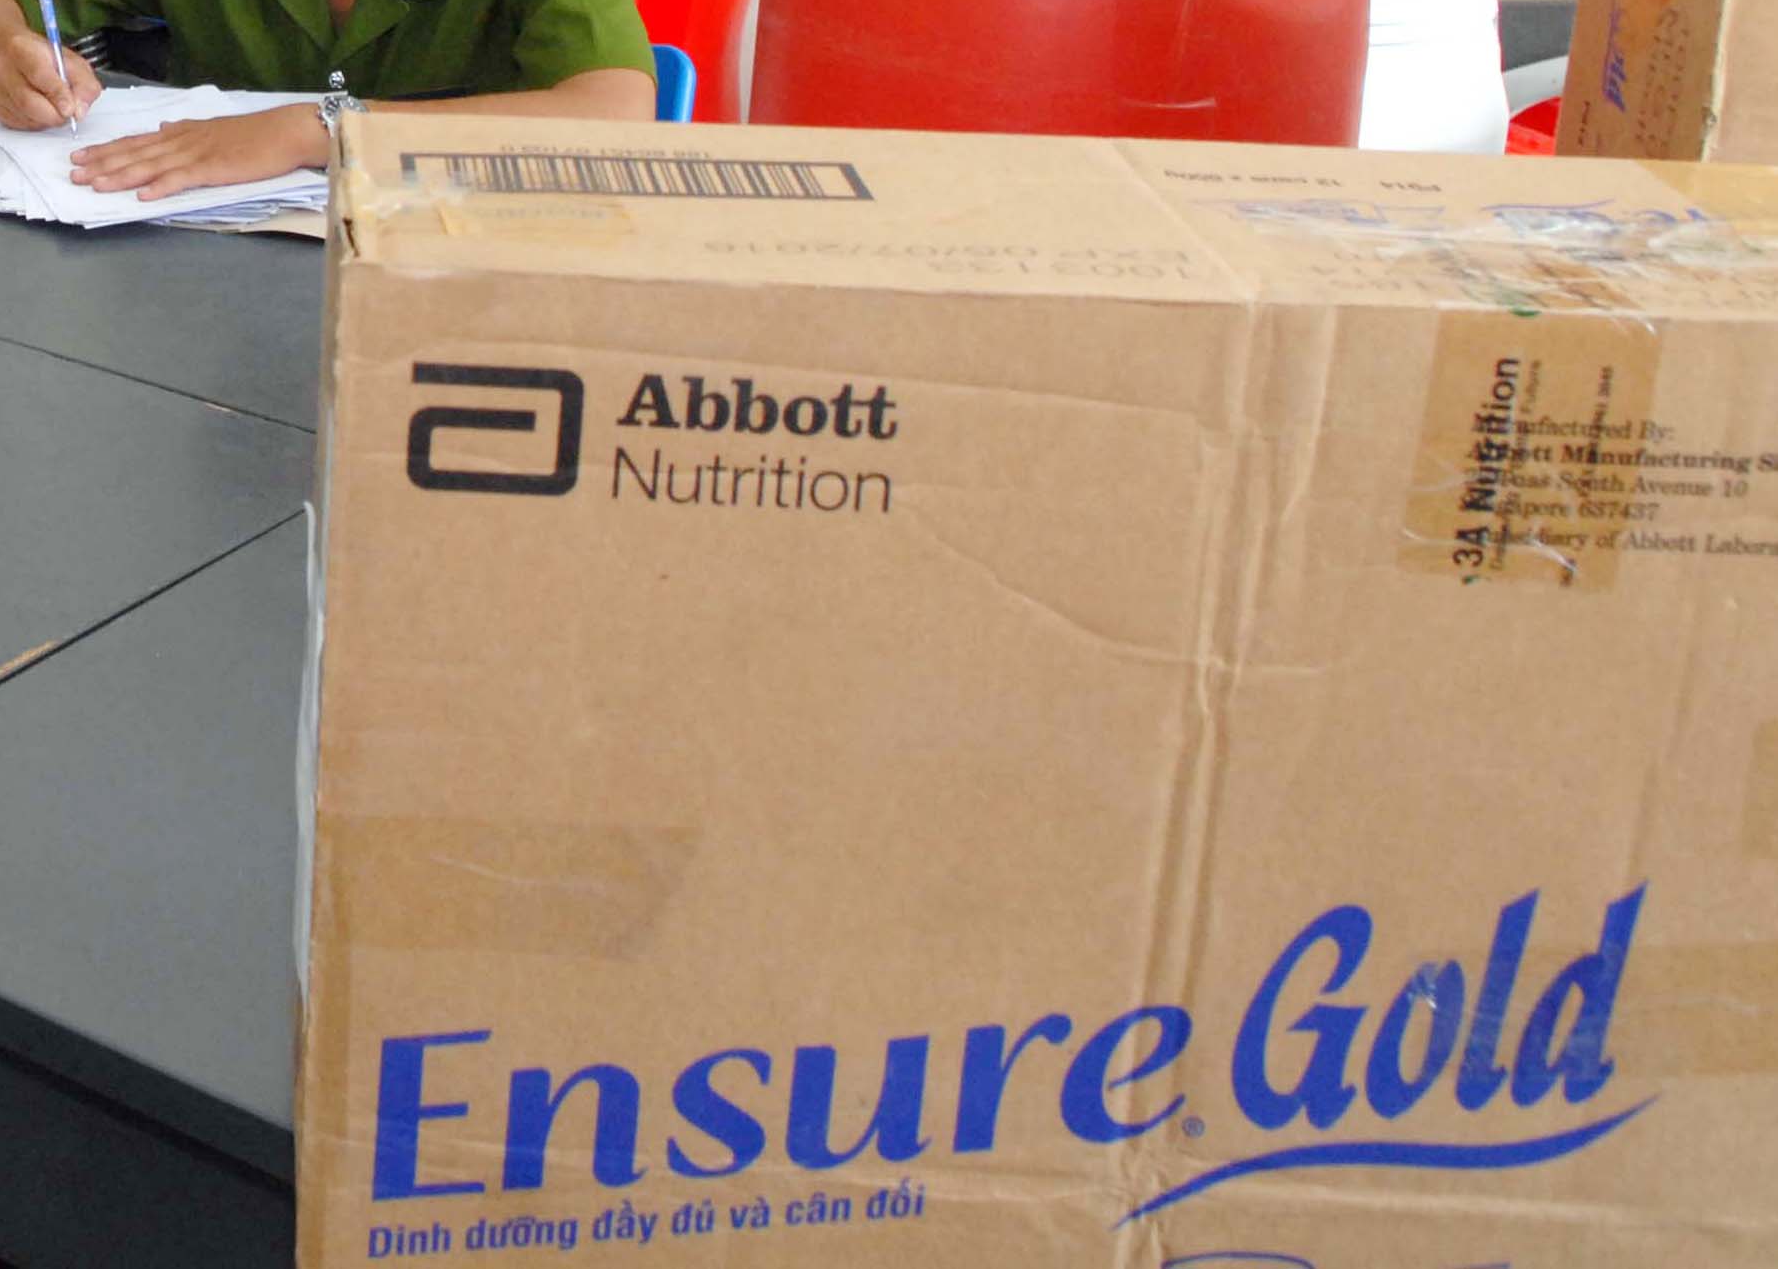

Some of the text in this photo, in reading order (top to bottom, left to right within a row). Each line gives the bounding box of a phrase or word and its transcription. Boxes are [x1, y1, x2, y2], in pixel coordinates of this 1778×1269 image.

[616, 373, 899, 440] Abbott
[611, 445, 893, 514] Nutrition
[1453, 357, 1520, 568] 3A Nutrition
[1633, 476, 1716, 499] Avenue
[1722, 481, 1750, 500] 10
[1595, 528, 1621, 550] of
[1624, 531, 1697, 554] Abbott
[370, 879, 1652, 1202] Ensure Gold
[368, 1175, 926, 1258] Dinh dưỡng đầy đủ và cân đối
